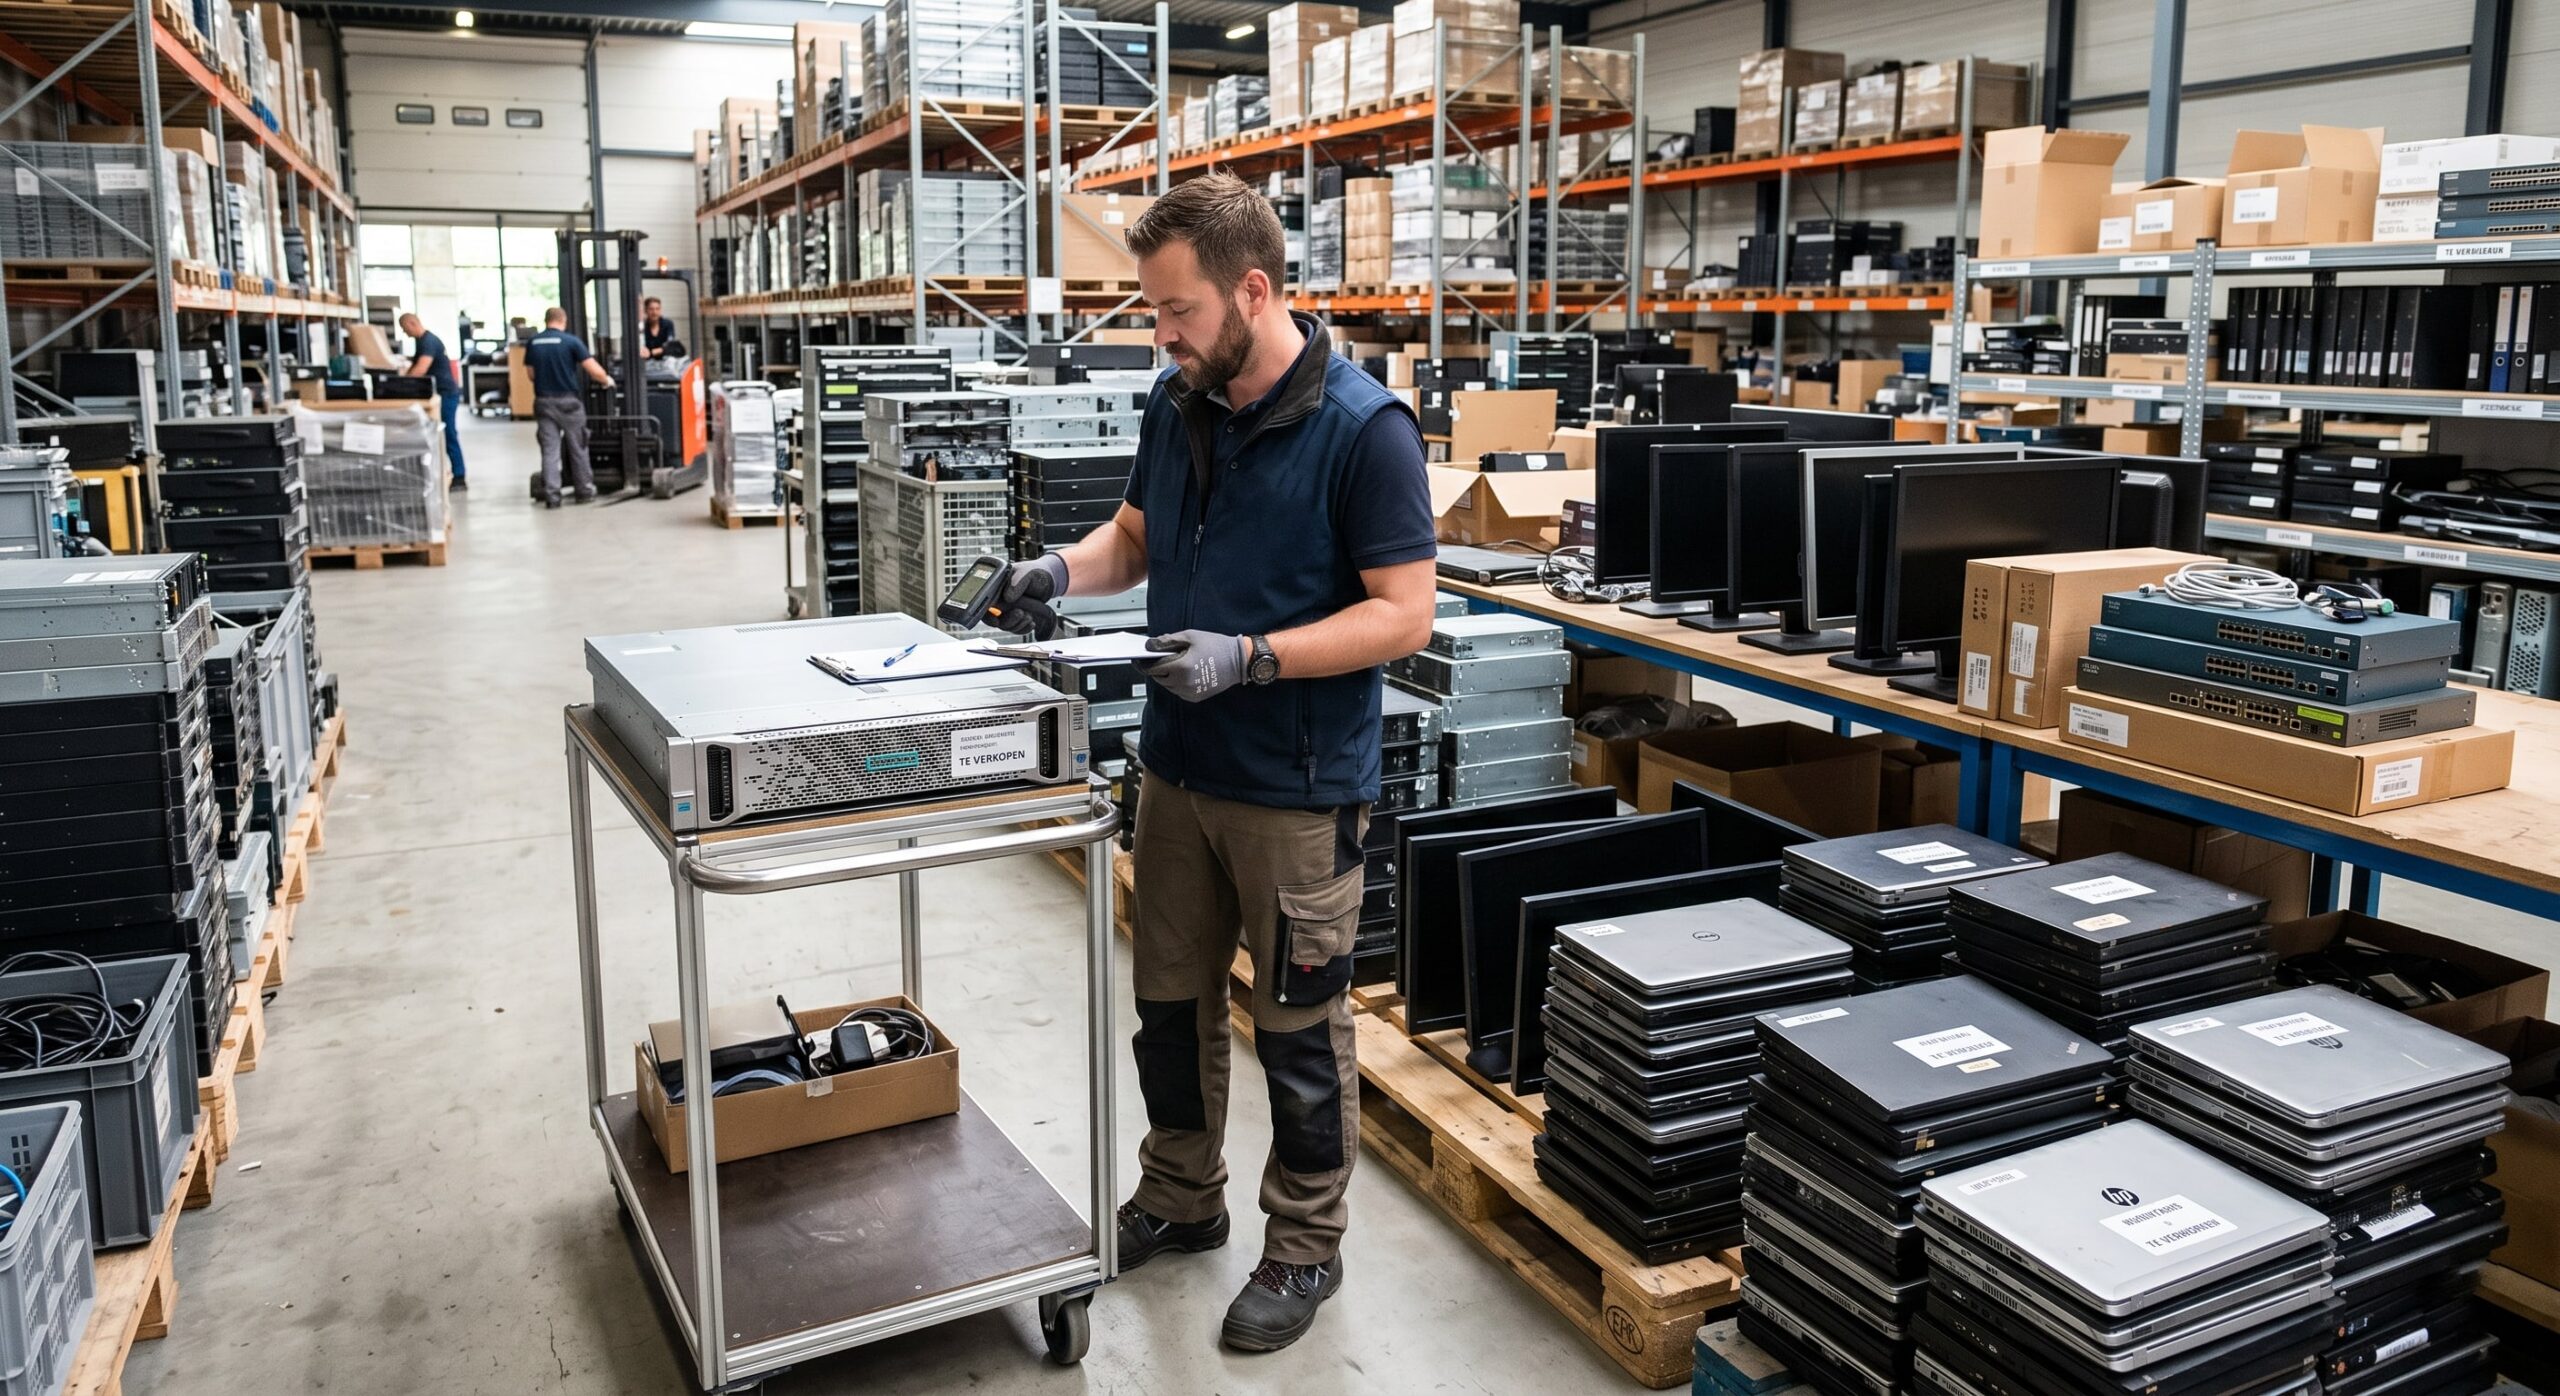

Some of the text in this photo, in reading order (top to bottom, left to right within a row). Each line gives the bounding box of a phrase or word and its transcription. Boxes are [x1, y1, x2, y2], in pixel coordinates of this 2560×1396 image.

[959, 750, 1026, 766] TE VERKOPEN
[2102, 1187, 2139, 1207] hp
